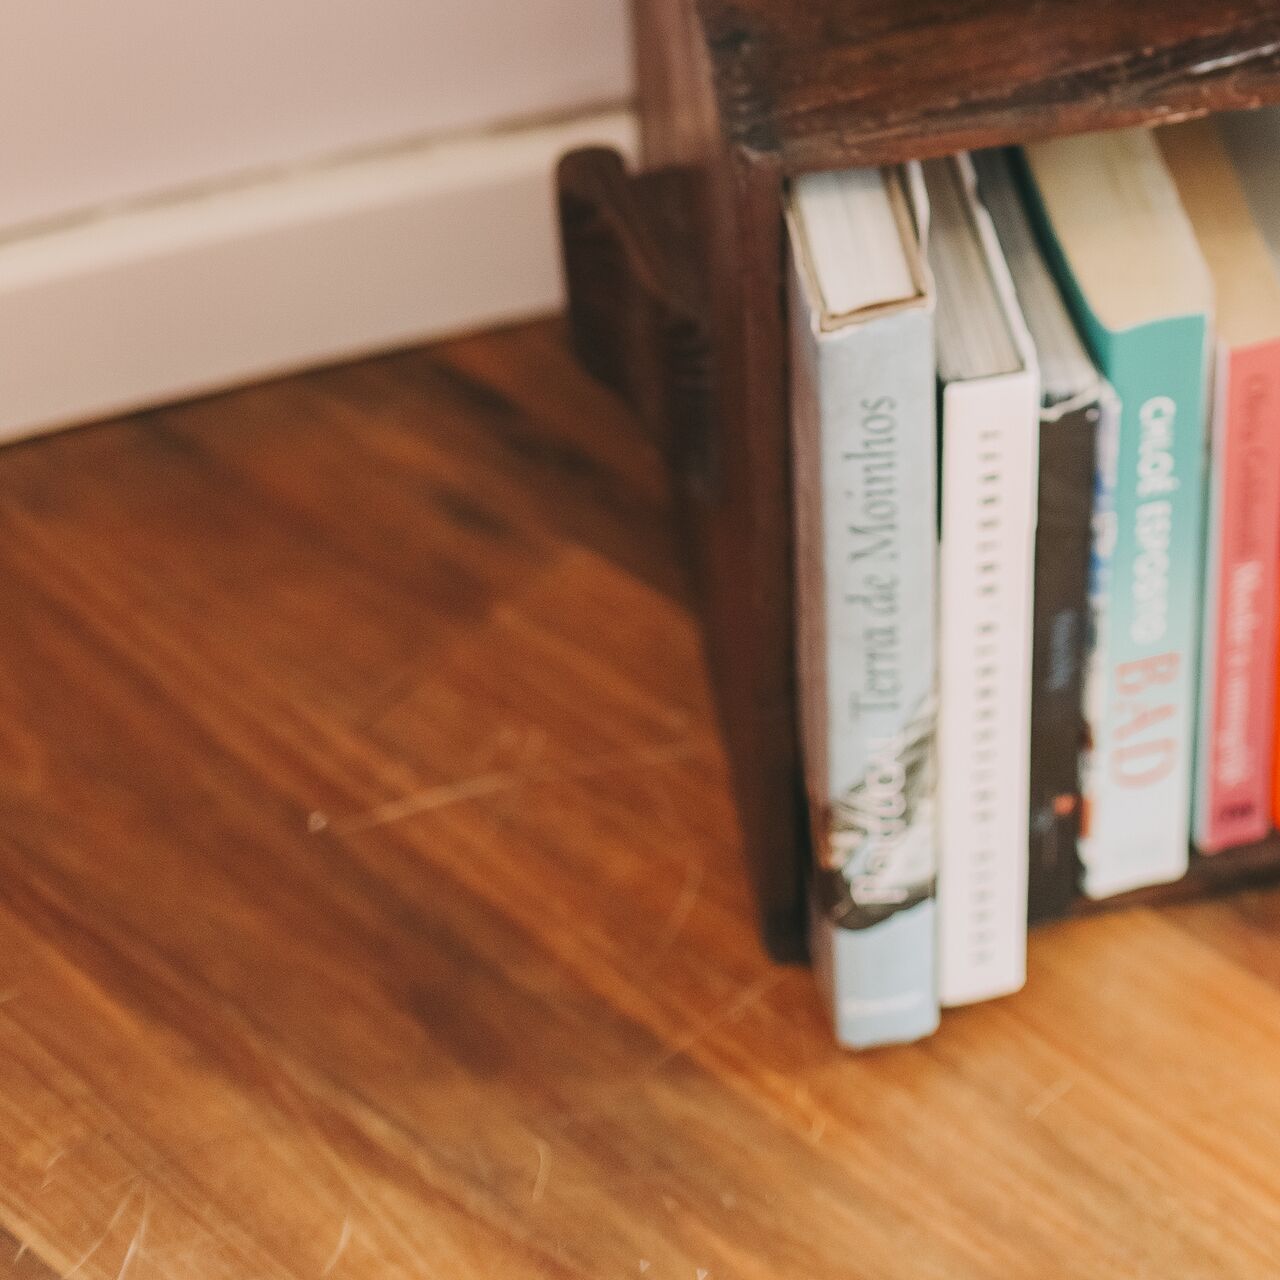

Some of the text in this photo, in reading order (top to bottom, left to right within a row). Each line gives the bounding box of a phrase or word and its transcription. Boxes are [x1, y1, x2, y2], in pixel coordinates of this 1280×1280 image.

[842, 396, 901, 721] Terra de Moinhos
[1109, 651, 1182, 791] BAD
